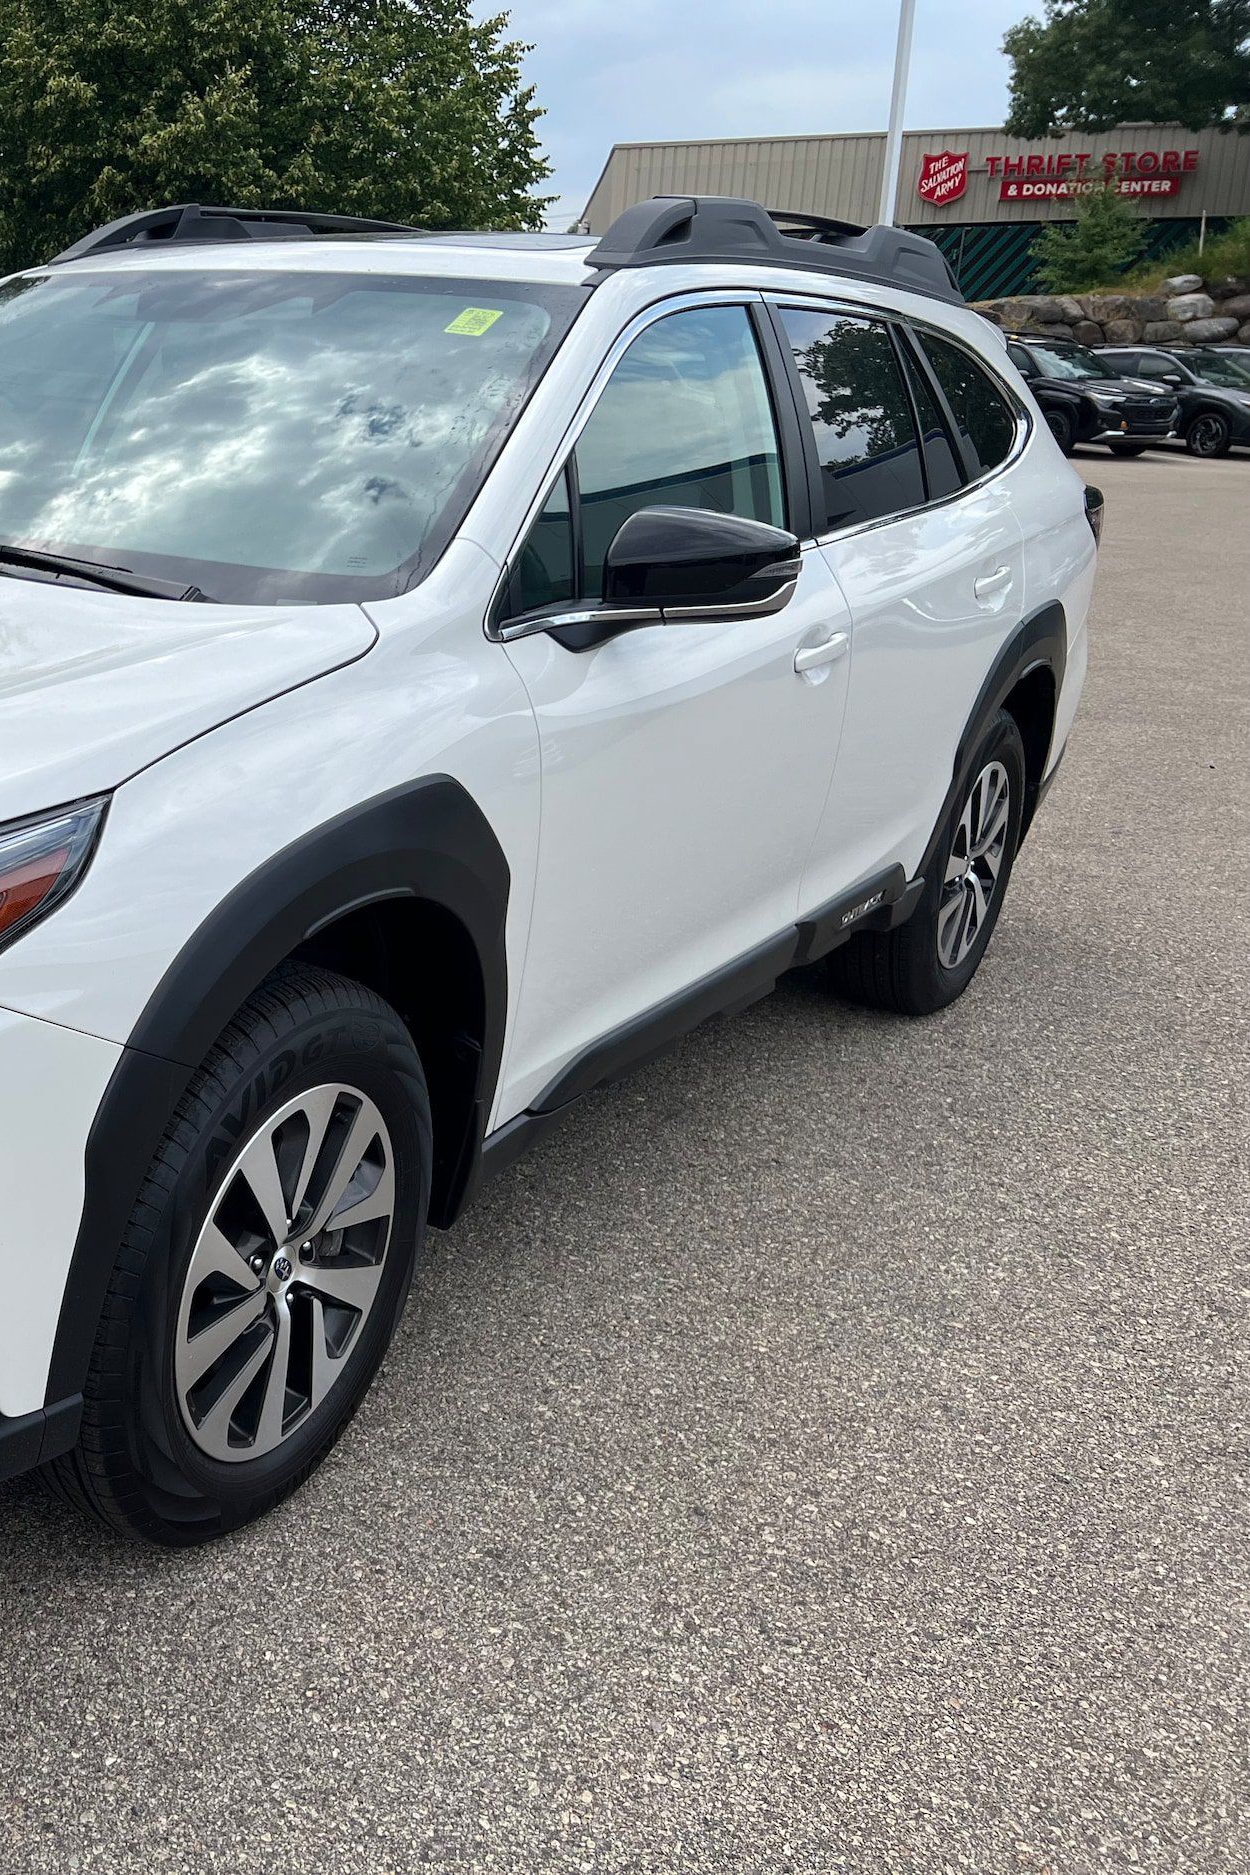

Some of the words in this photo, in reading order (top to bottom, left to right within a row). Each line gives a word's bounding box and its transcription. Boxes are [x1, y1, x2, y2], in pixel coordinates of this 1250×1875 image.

[920, 158, 965, 193] SALVATION
[929, 156, 949, 175] THE
[986, 153, 1091, 177] THRIFT
[1102, 150, 1199, 174] STORE
[933, 173, 962, 199] ARMY
[1007, 184, 1018, 196] &
